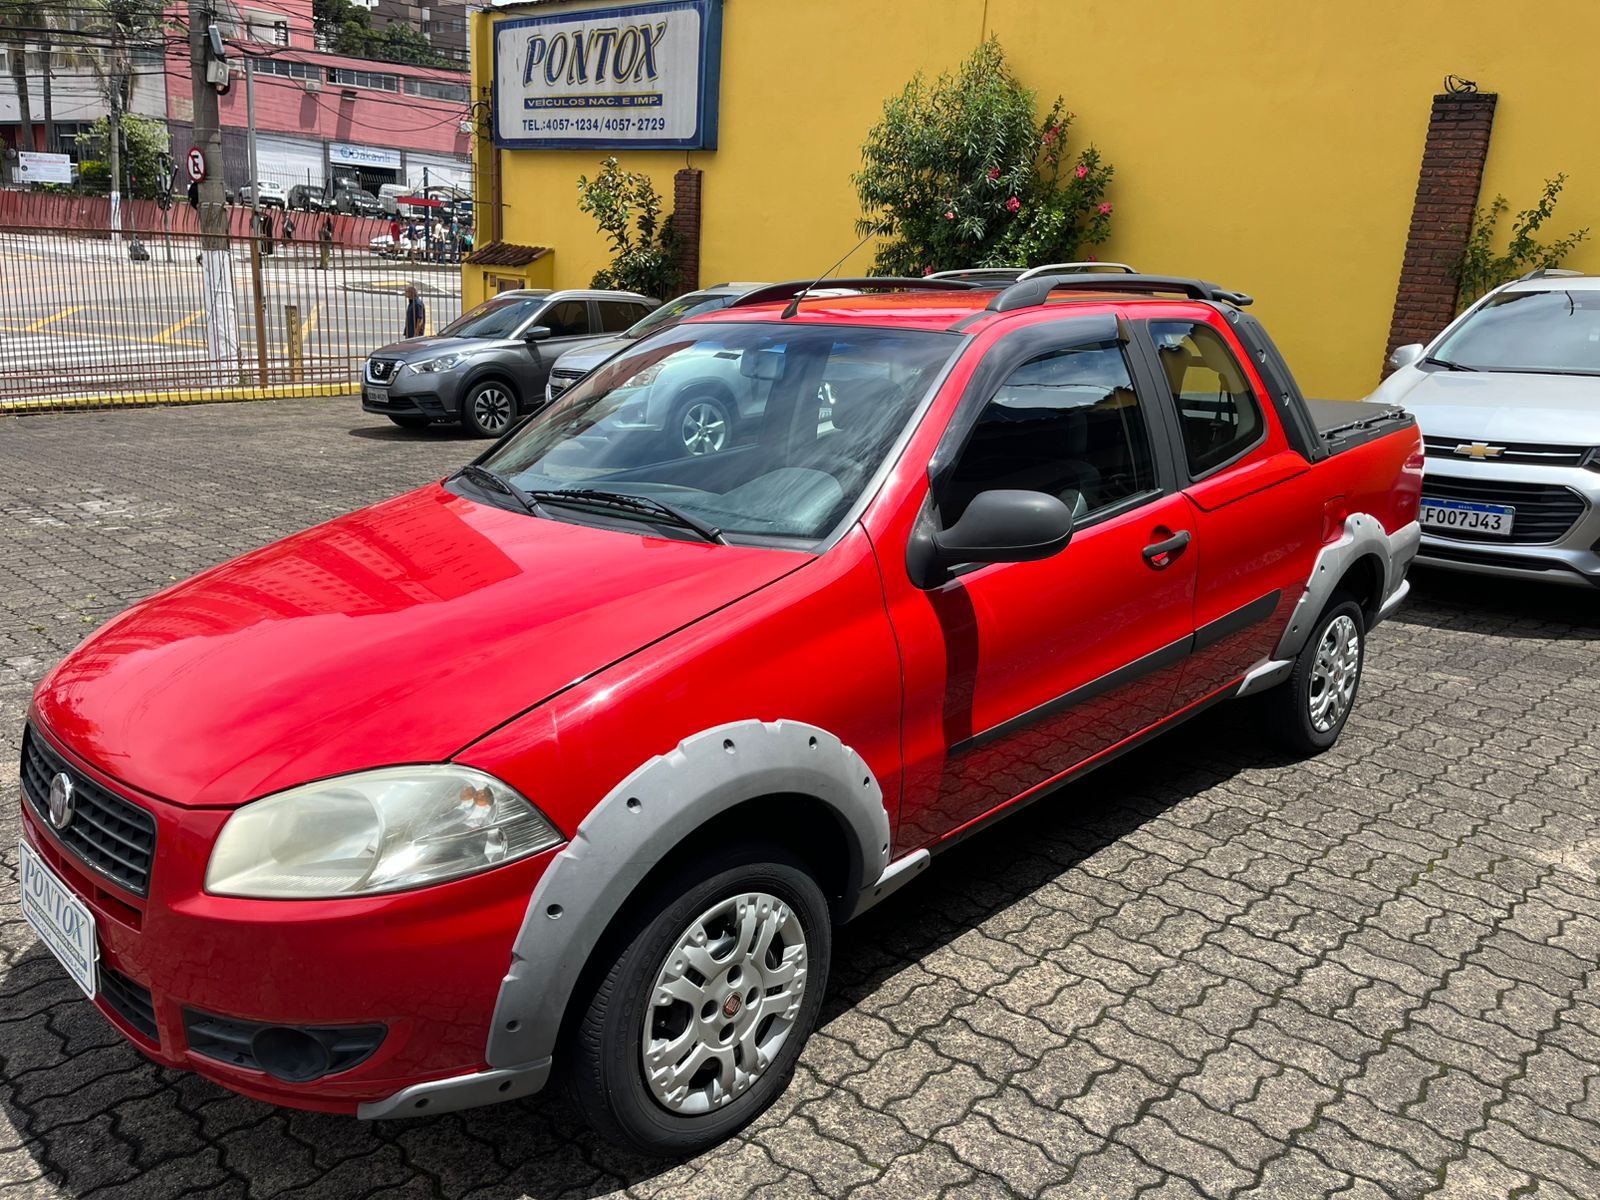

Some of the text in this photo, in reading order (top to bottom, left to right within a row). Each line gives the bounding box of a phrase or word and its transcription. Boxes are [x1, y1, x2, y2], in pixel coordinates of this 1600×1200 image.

[522, 20, 668, 88] PONTOX
[588, 96, 618, 106] NAC.
[622, 97, 631, 105] E
[24, 857, 85, 951] PONTOX
